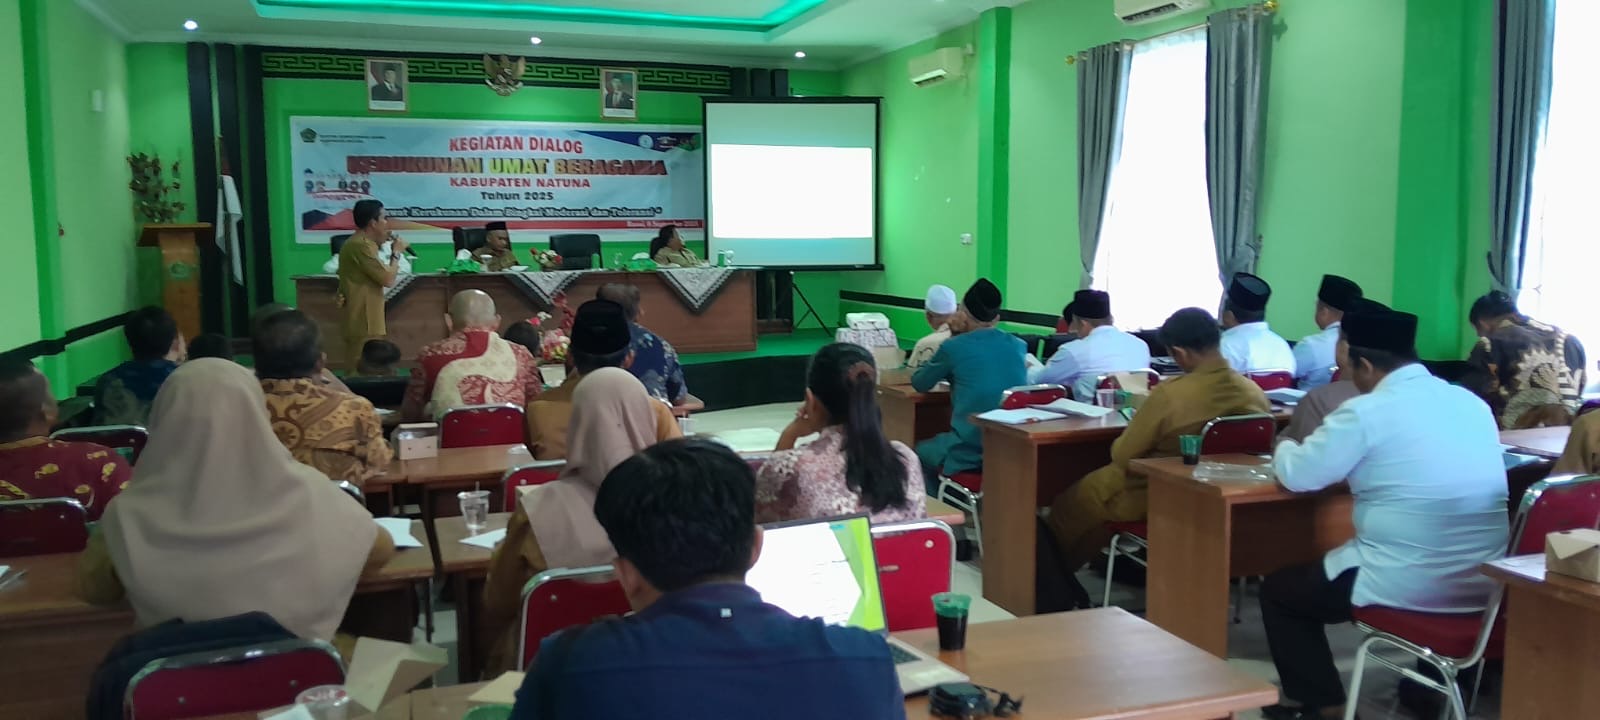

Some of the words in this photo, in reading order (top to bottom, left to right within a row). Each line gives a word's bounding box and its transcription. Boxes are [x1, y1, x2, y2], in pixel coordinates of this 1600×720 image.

[449, 136, 523, 151] KEGIATAN
[529, 136, 584, 154] DIALOG
[489, 157, 549, 174] UMAT
[554, 158, 668, 176] BERAGAMA
[449, 177, 531, 187] KABUPATEN
[536, 178, 591, 188] NATUNA
[480, 191, 519, 200] Tahun
[524, 192, 554, 200] 2025
[410, 206, 469, 218] Kerukunan
[469, 206, 505, 218] Dalam
[505, 206, 544, 220] Bingkai
[544, 206, 590, 218] Moderasi
[590, 206, 611, 218] dan
